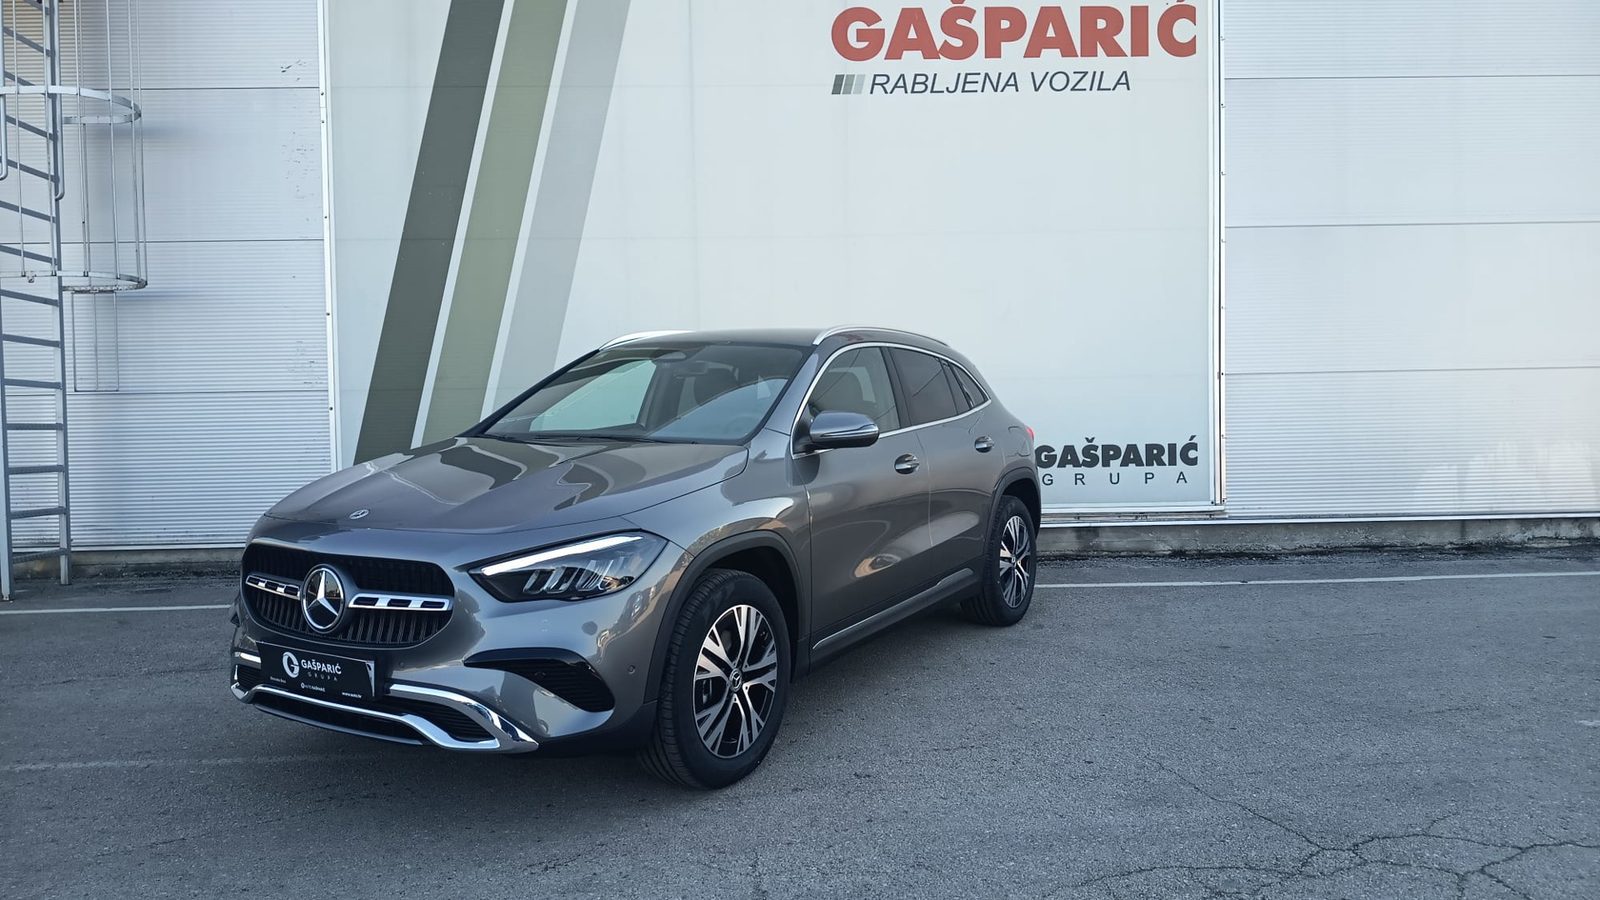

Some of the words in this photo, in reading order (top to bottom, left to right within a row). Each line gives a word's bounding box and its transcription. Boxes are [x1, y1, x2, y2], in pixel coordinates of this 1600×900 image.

[831, 0, 1197, 62] GAŠPARIĆ
[869, 72, 1020, 95] RABLJENA
[1030, 70, 1131, 92] VOZILA
[1034, 435, 1199, 468] GAŠPARIĆ
[301, 659, 342, 675] GAŠPARIĆ
